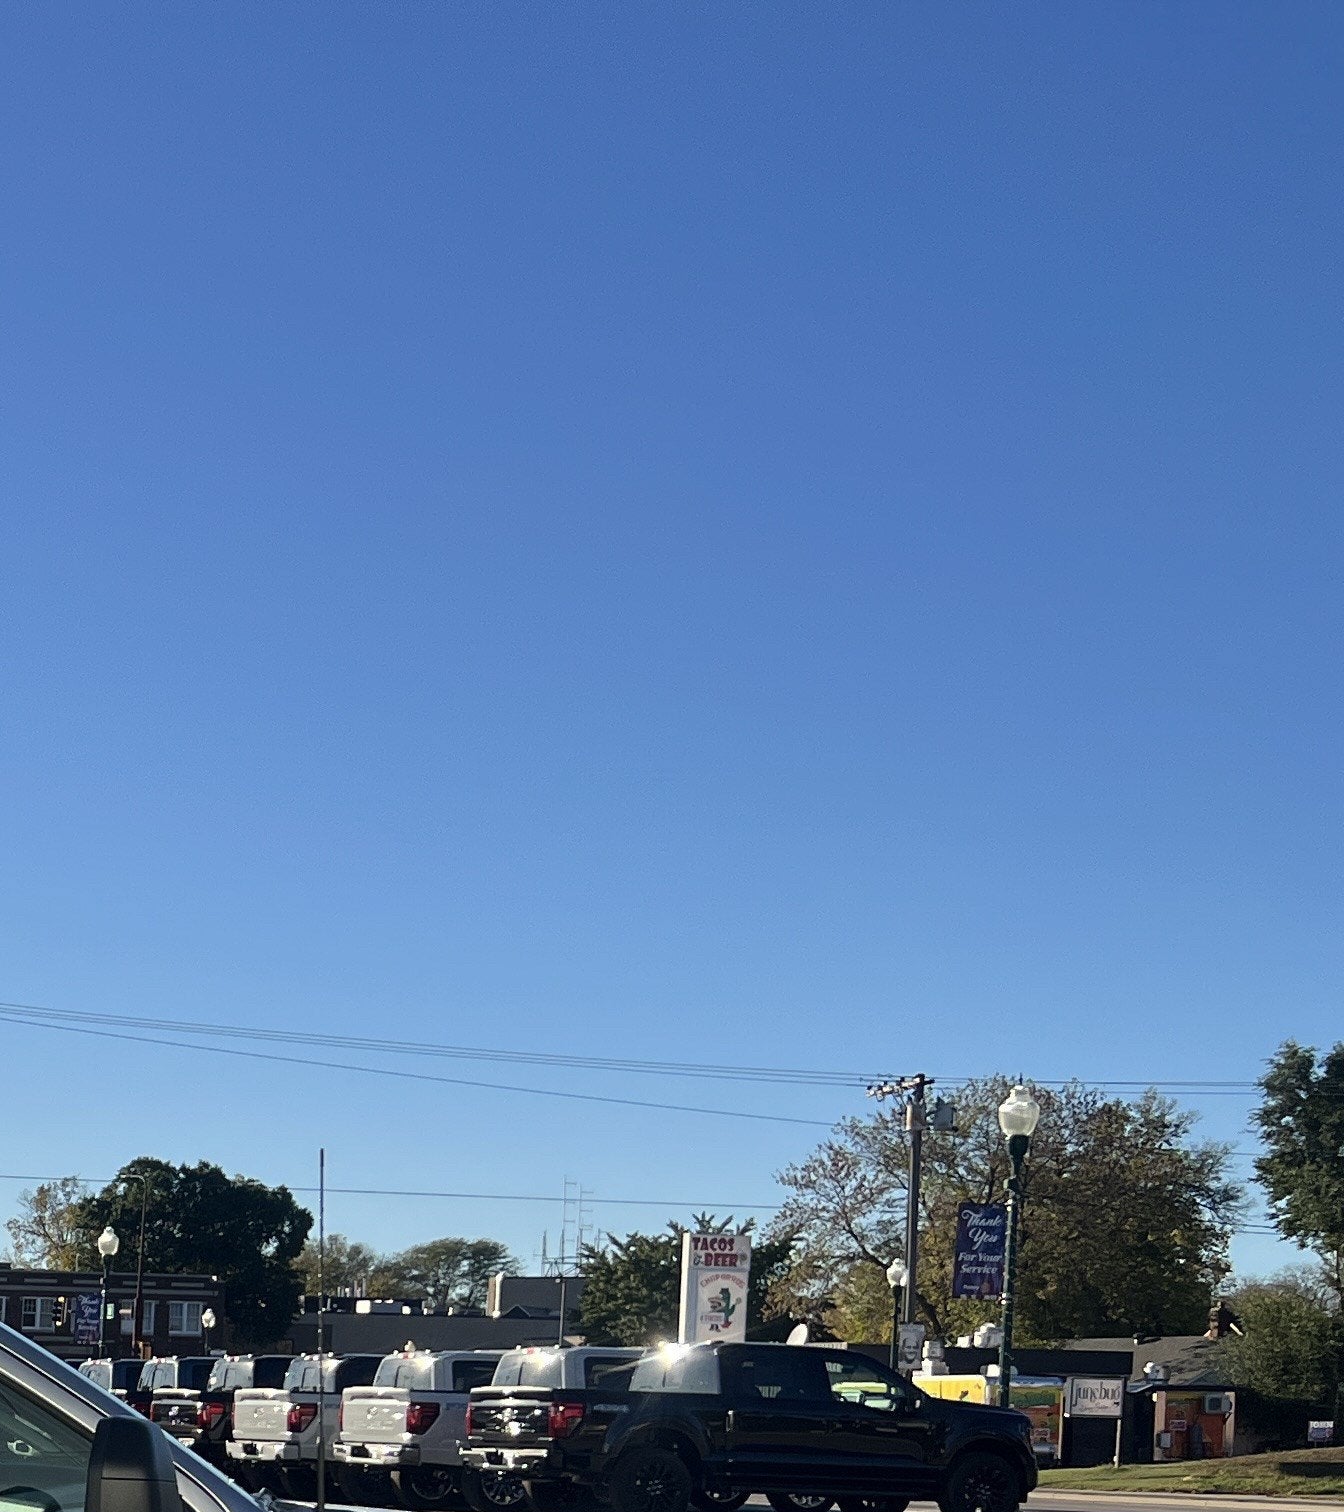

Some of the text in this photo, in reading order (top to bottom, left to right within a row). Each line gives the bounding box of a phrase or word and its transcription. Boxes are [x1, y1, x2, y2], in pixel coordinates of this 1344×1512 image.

[961, 1209, 1003, 1227] Thank
[693, 1237, 735, 1251] TACOS
[968, 1227, 999, 1250] You
[704, 1253, 739, 1267] BEER
[958, 1251, 1003, 1262] For Your
[960, 1263, 998, 1274] Service
